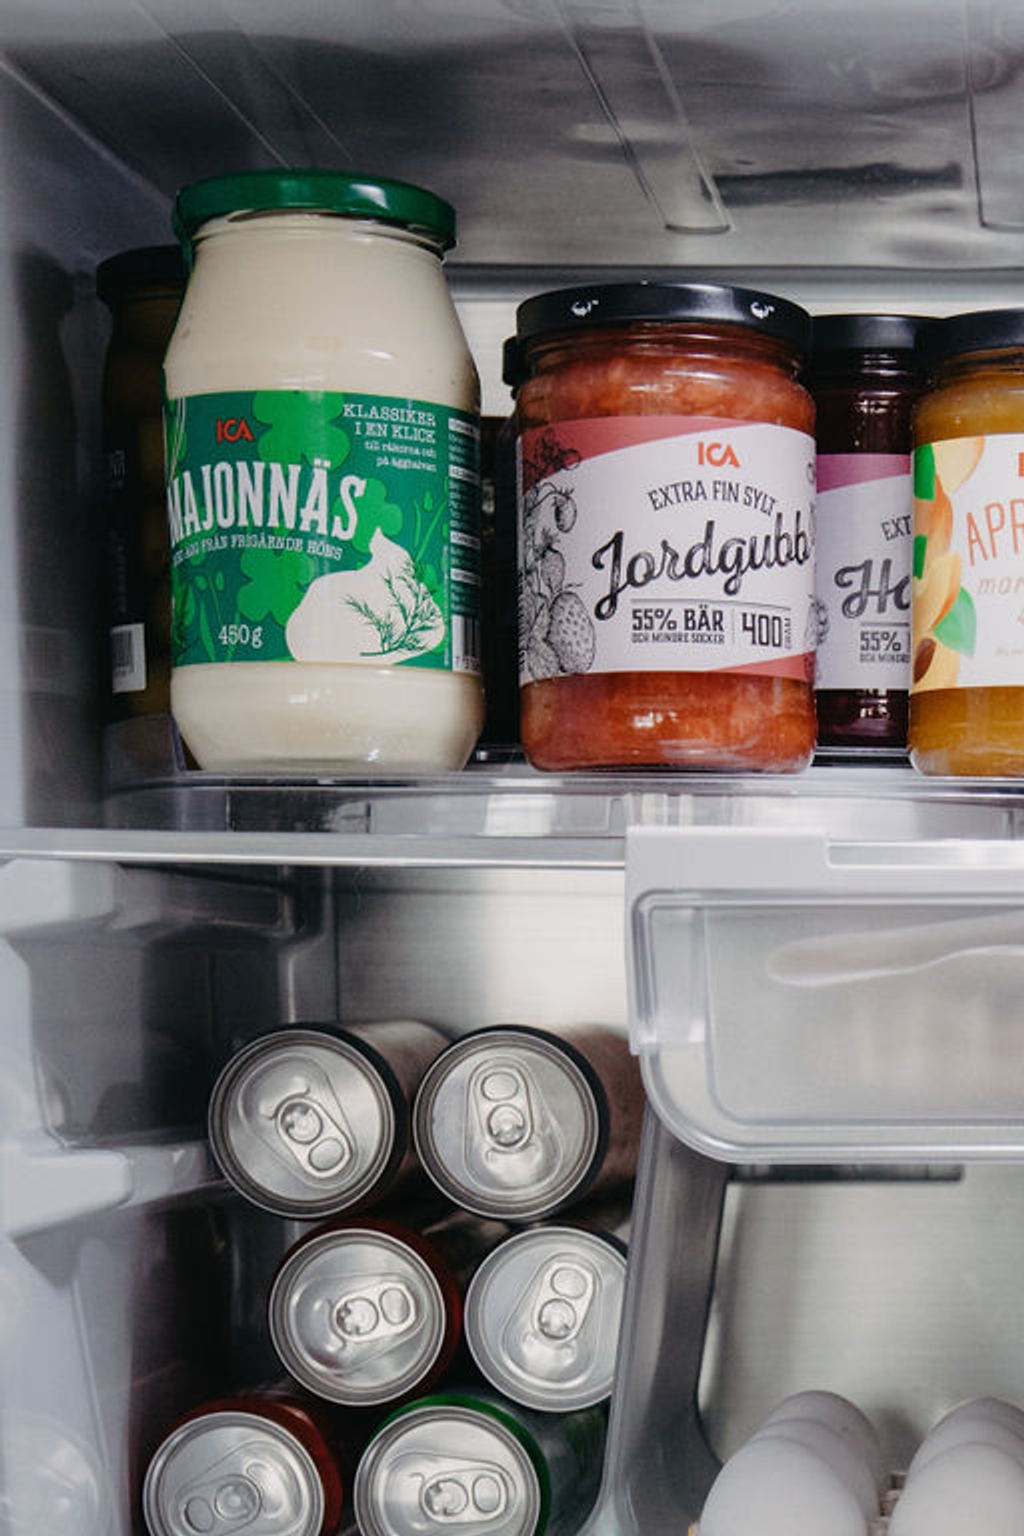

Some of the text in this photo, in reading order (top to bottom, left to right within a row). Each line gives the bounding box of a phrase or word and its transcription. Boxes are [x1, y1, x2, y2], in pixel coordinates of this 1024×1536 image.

[343, 404, 435, 427] KLASSIKER
[216, 418, 254, 443] ICA
[355, 422, 436, 444] I EN KLICK
[697, 441, 741, 468] ICA
[167, 457, 367, 548] MAJONNÄS
[648, 480, 776, 517] EXTRA FIN SYLT
[592, 510, 811, 622] Jordgubb
[632, 604, 724, 632] 55% BÄR
[742, 612, 783, 648] 400
[860, 631, 902, 652] 55%
